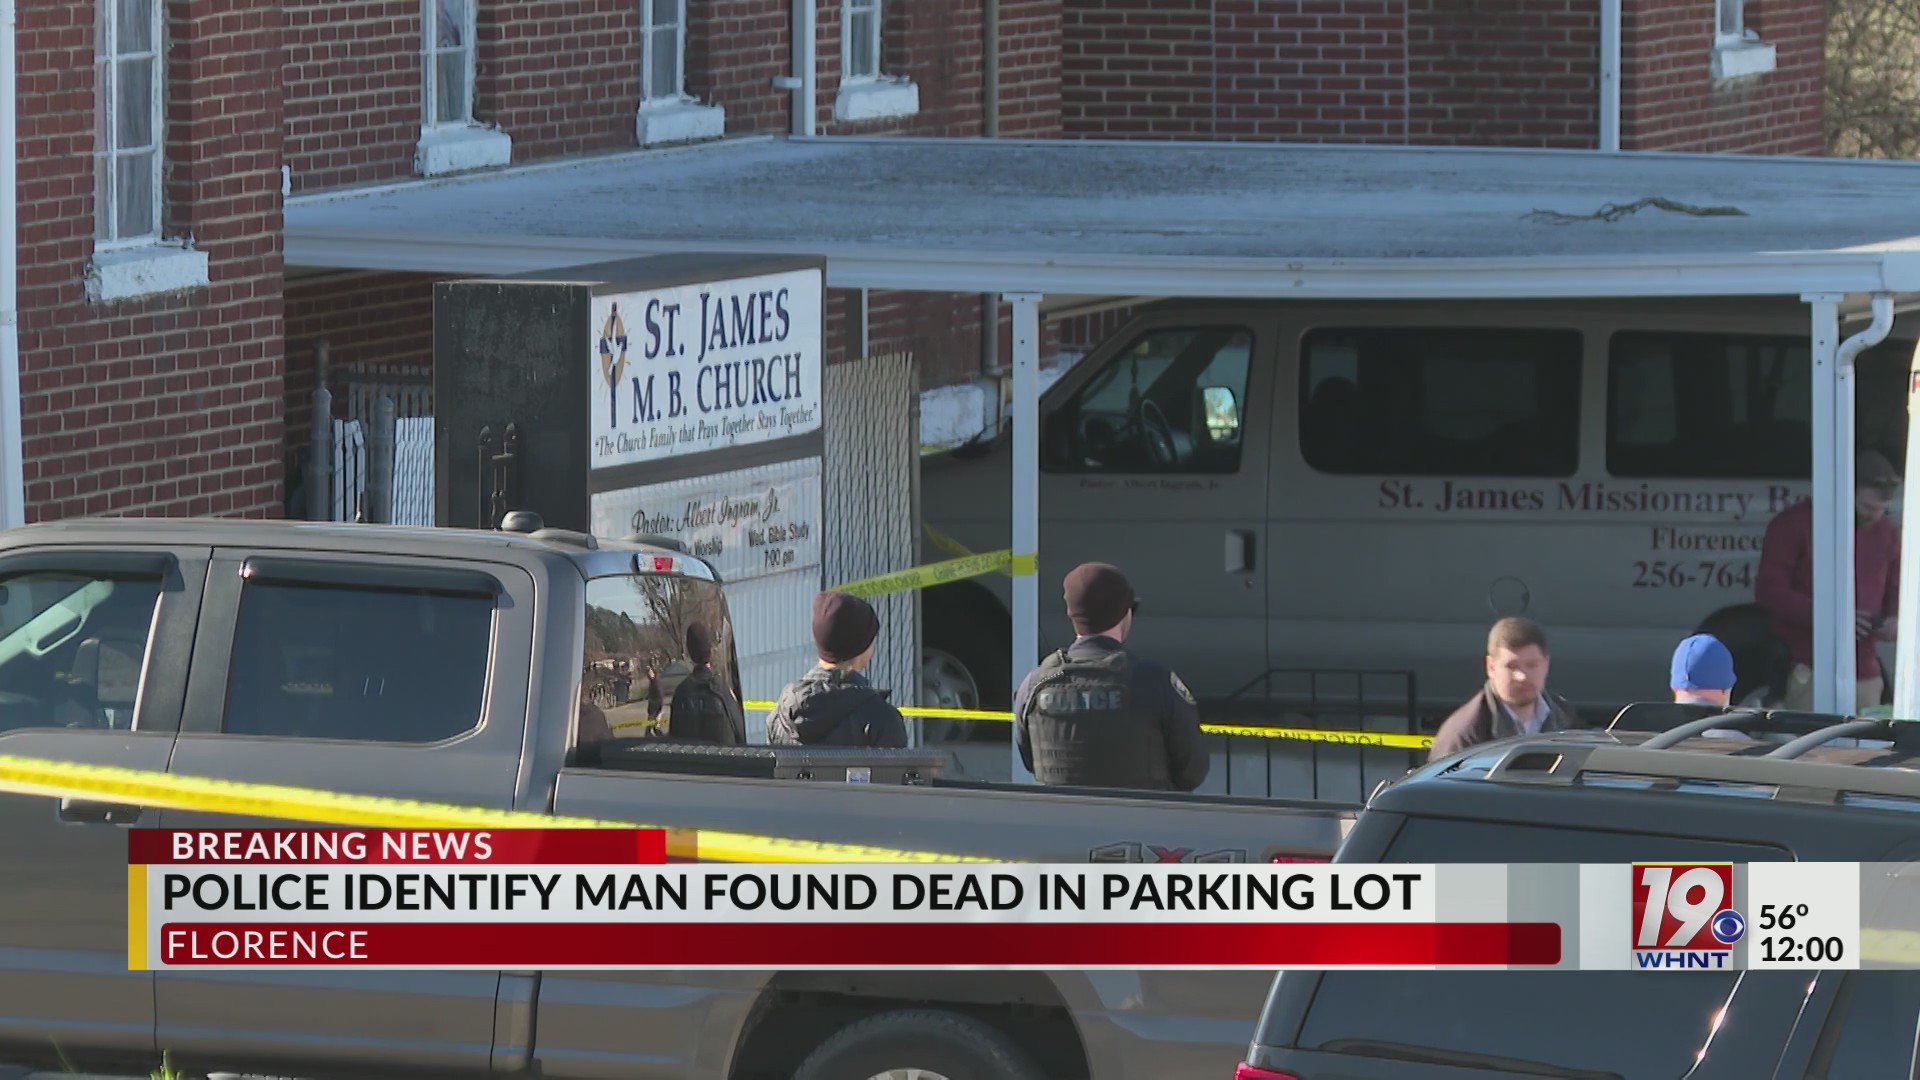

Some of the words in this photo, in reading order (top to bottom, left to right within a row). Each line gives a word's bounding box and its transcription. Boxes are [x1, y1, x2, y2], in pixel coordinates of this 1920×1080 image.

[645, 298, 685, 360] ST.
[697, 287, 790, 363] JAMES
[631, 374, 661, 424] M.
[668, 371, 688, 418] B.
[696, 352, 802, 414] CHURCH
[617, 429, 647, 454] Church
[649, 424, 677, 453] Family
[679, 423, 695, 443] that
[697, 418, 718, 447] Prays
[722, 413, 755, 444] Together
[757, 409, 777, 438] Stays
[1378, 479, 1424, 509] St.
[1435, 480, 1545, 512] James
[1557, 482, 1752, 520] Missionary
[632, 509, 673, 534] Pastor:
[676, 500, 716, 532] Albert
[768, 525, 786, 543] Bible
[789, 520, 809, 540] Study
[694, 536, 723, 557] Worship
[1651, 526, 1764, 551] Florence
[1632, 560, 1754, 589] 256-764
